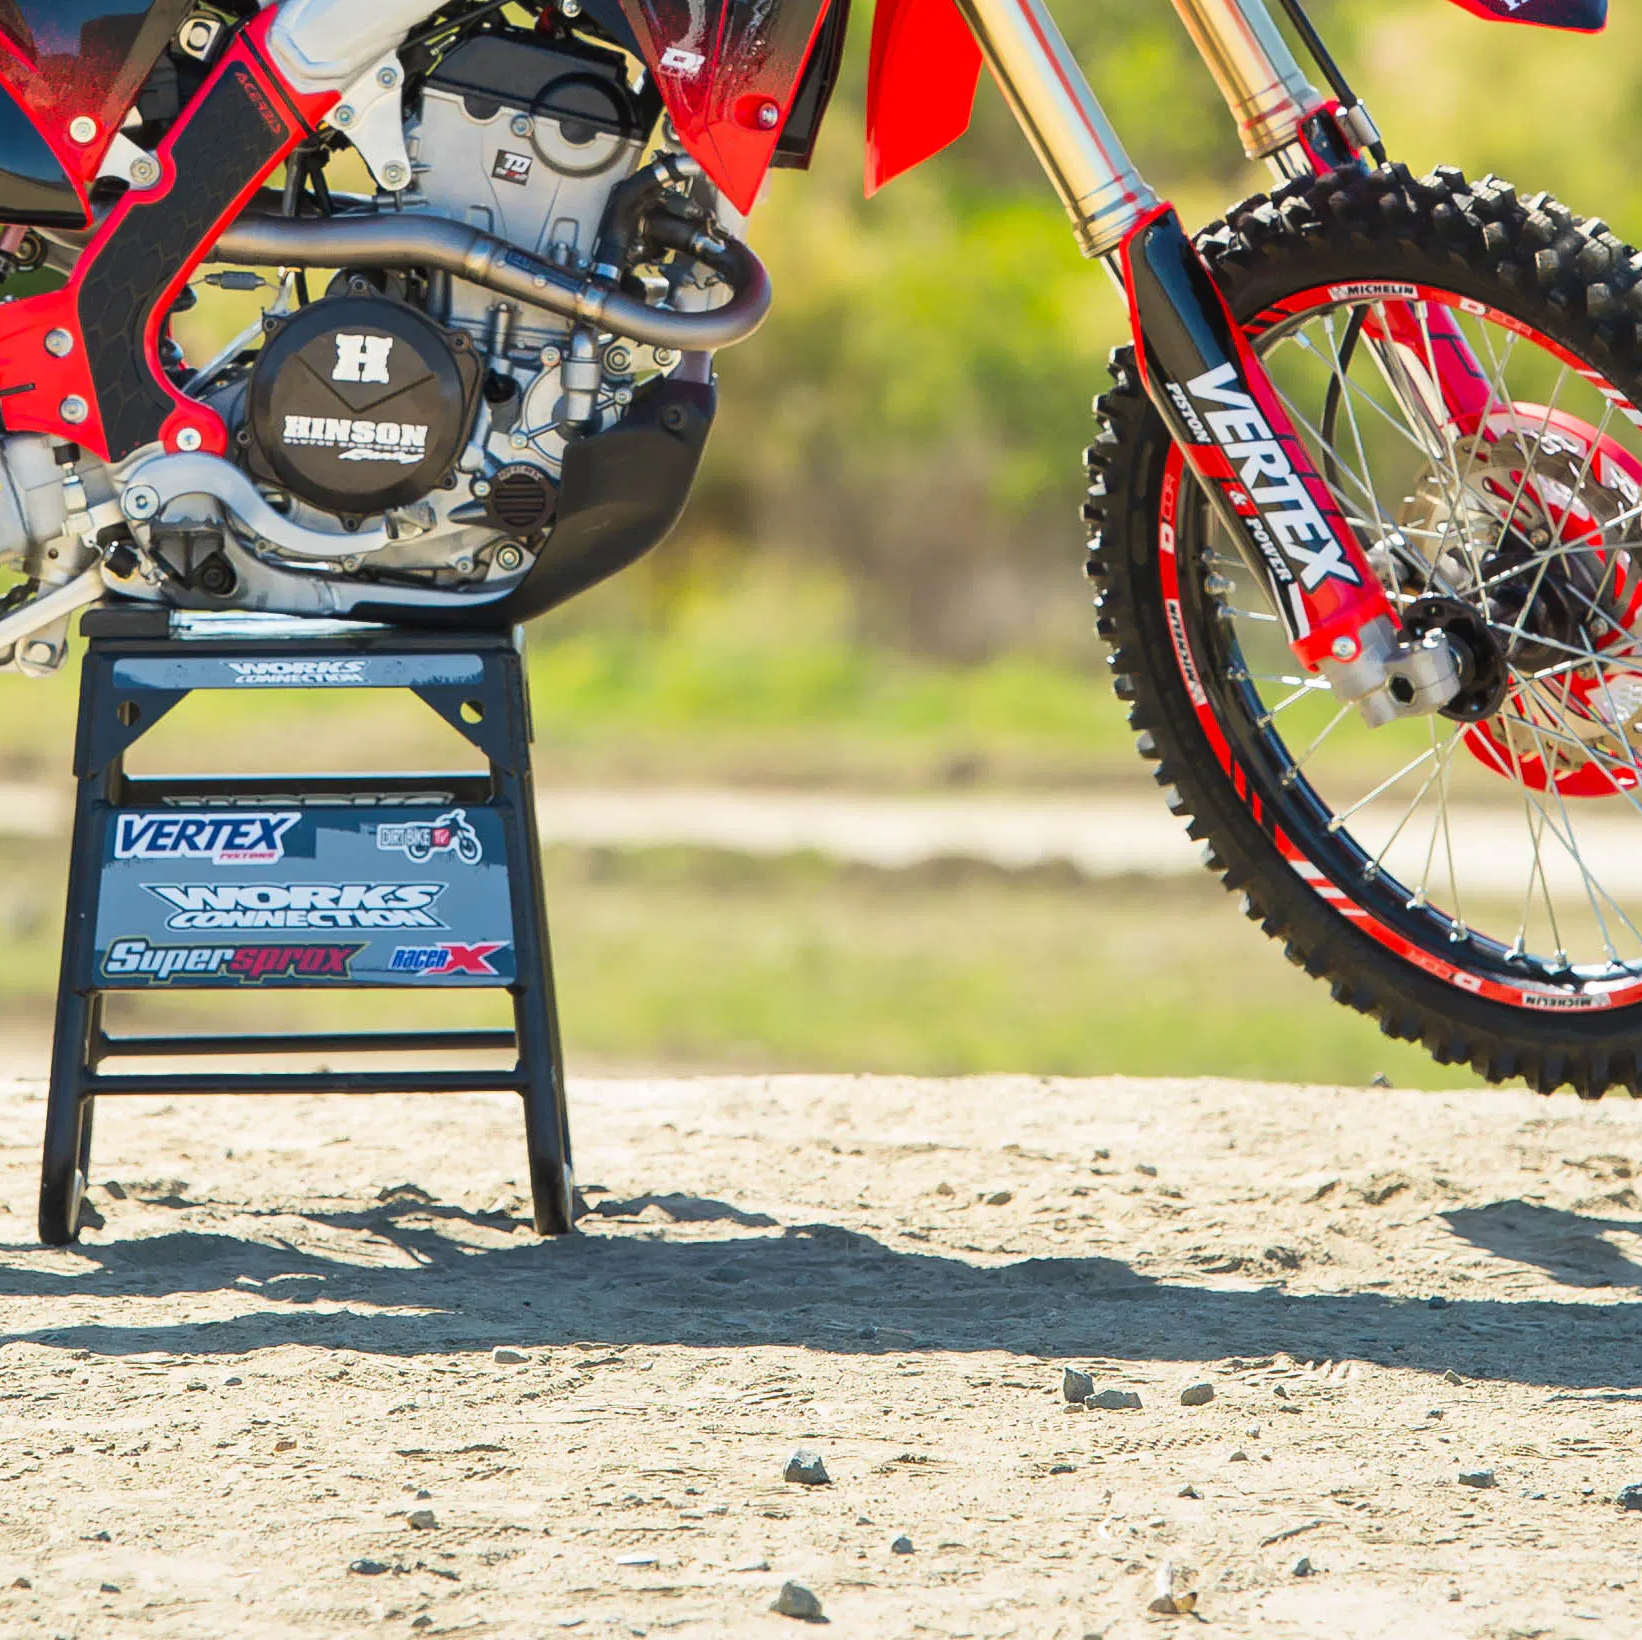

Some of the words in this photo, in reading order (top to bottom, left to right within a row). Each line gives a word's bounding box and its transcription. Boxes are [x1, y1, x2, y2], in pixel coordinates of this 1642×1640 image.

[1347, 284, 1414, 295] MICHELIN
[332, 334, 393, 384] H
[283, 415, 428, 447] HINSON
[1165, 382, 1213, 444] PISTON
[1245, 518, 1294, 581] POWER
[1186, 362, 1361, 590] VERTEX
[229, 661, 366, 674] WORKS
[122, 817, 291, 852] VERTEX
[381, 829, 405, 845] DIRT
[407, 829, 431, 846] BIKE
[155, 884, 440, 910] WORKS
[170, 909, 440, 928] CONNECTION
[107, 941, 351, 979] Supersprox
[1525, 995, 1592, 1008] MICHELIN
